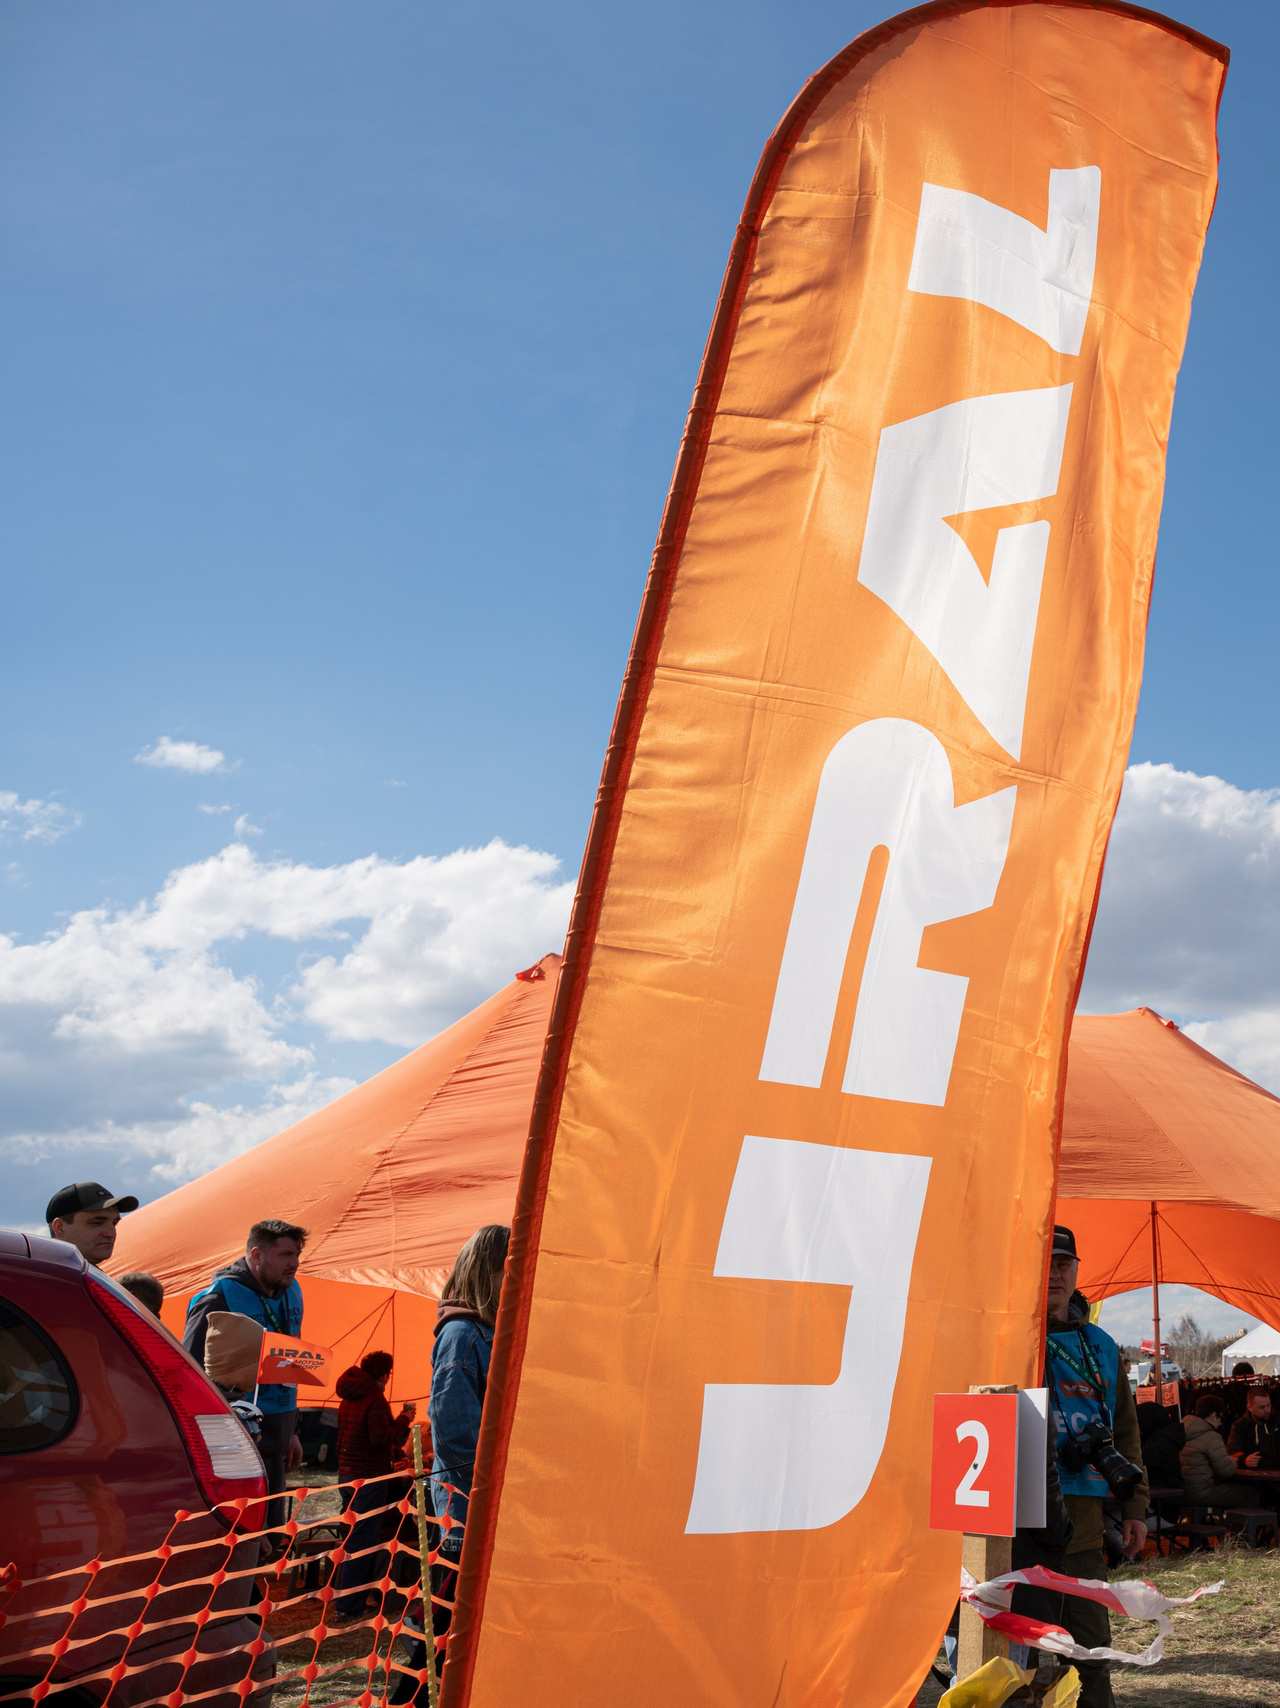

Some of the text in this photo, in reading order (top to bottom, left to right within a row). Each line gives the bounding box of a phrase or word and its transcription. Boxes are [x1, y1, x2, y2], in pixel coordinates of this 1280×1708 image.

[686, 166, 1101, 1535] URAL
[270, 1348, 325, 1360] URAL
[955, 1419, 990, 1507] 2
